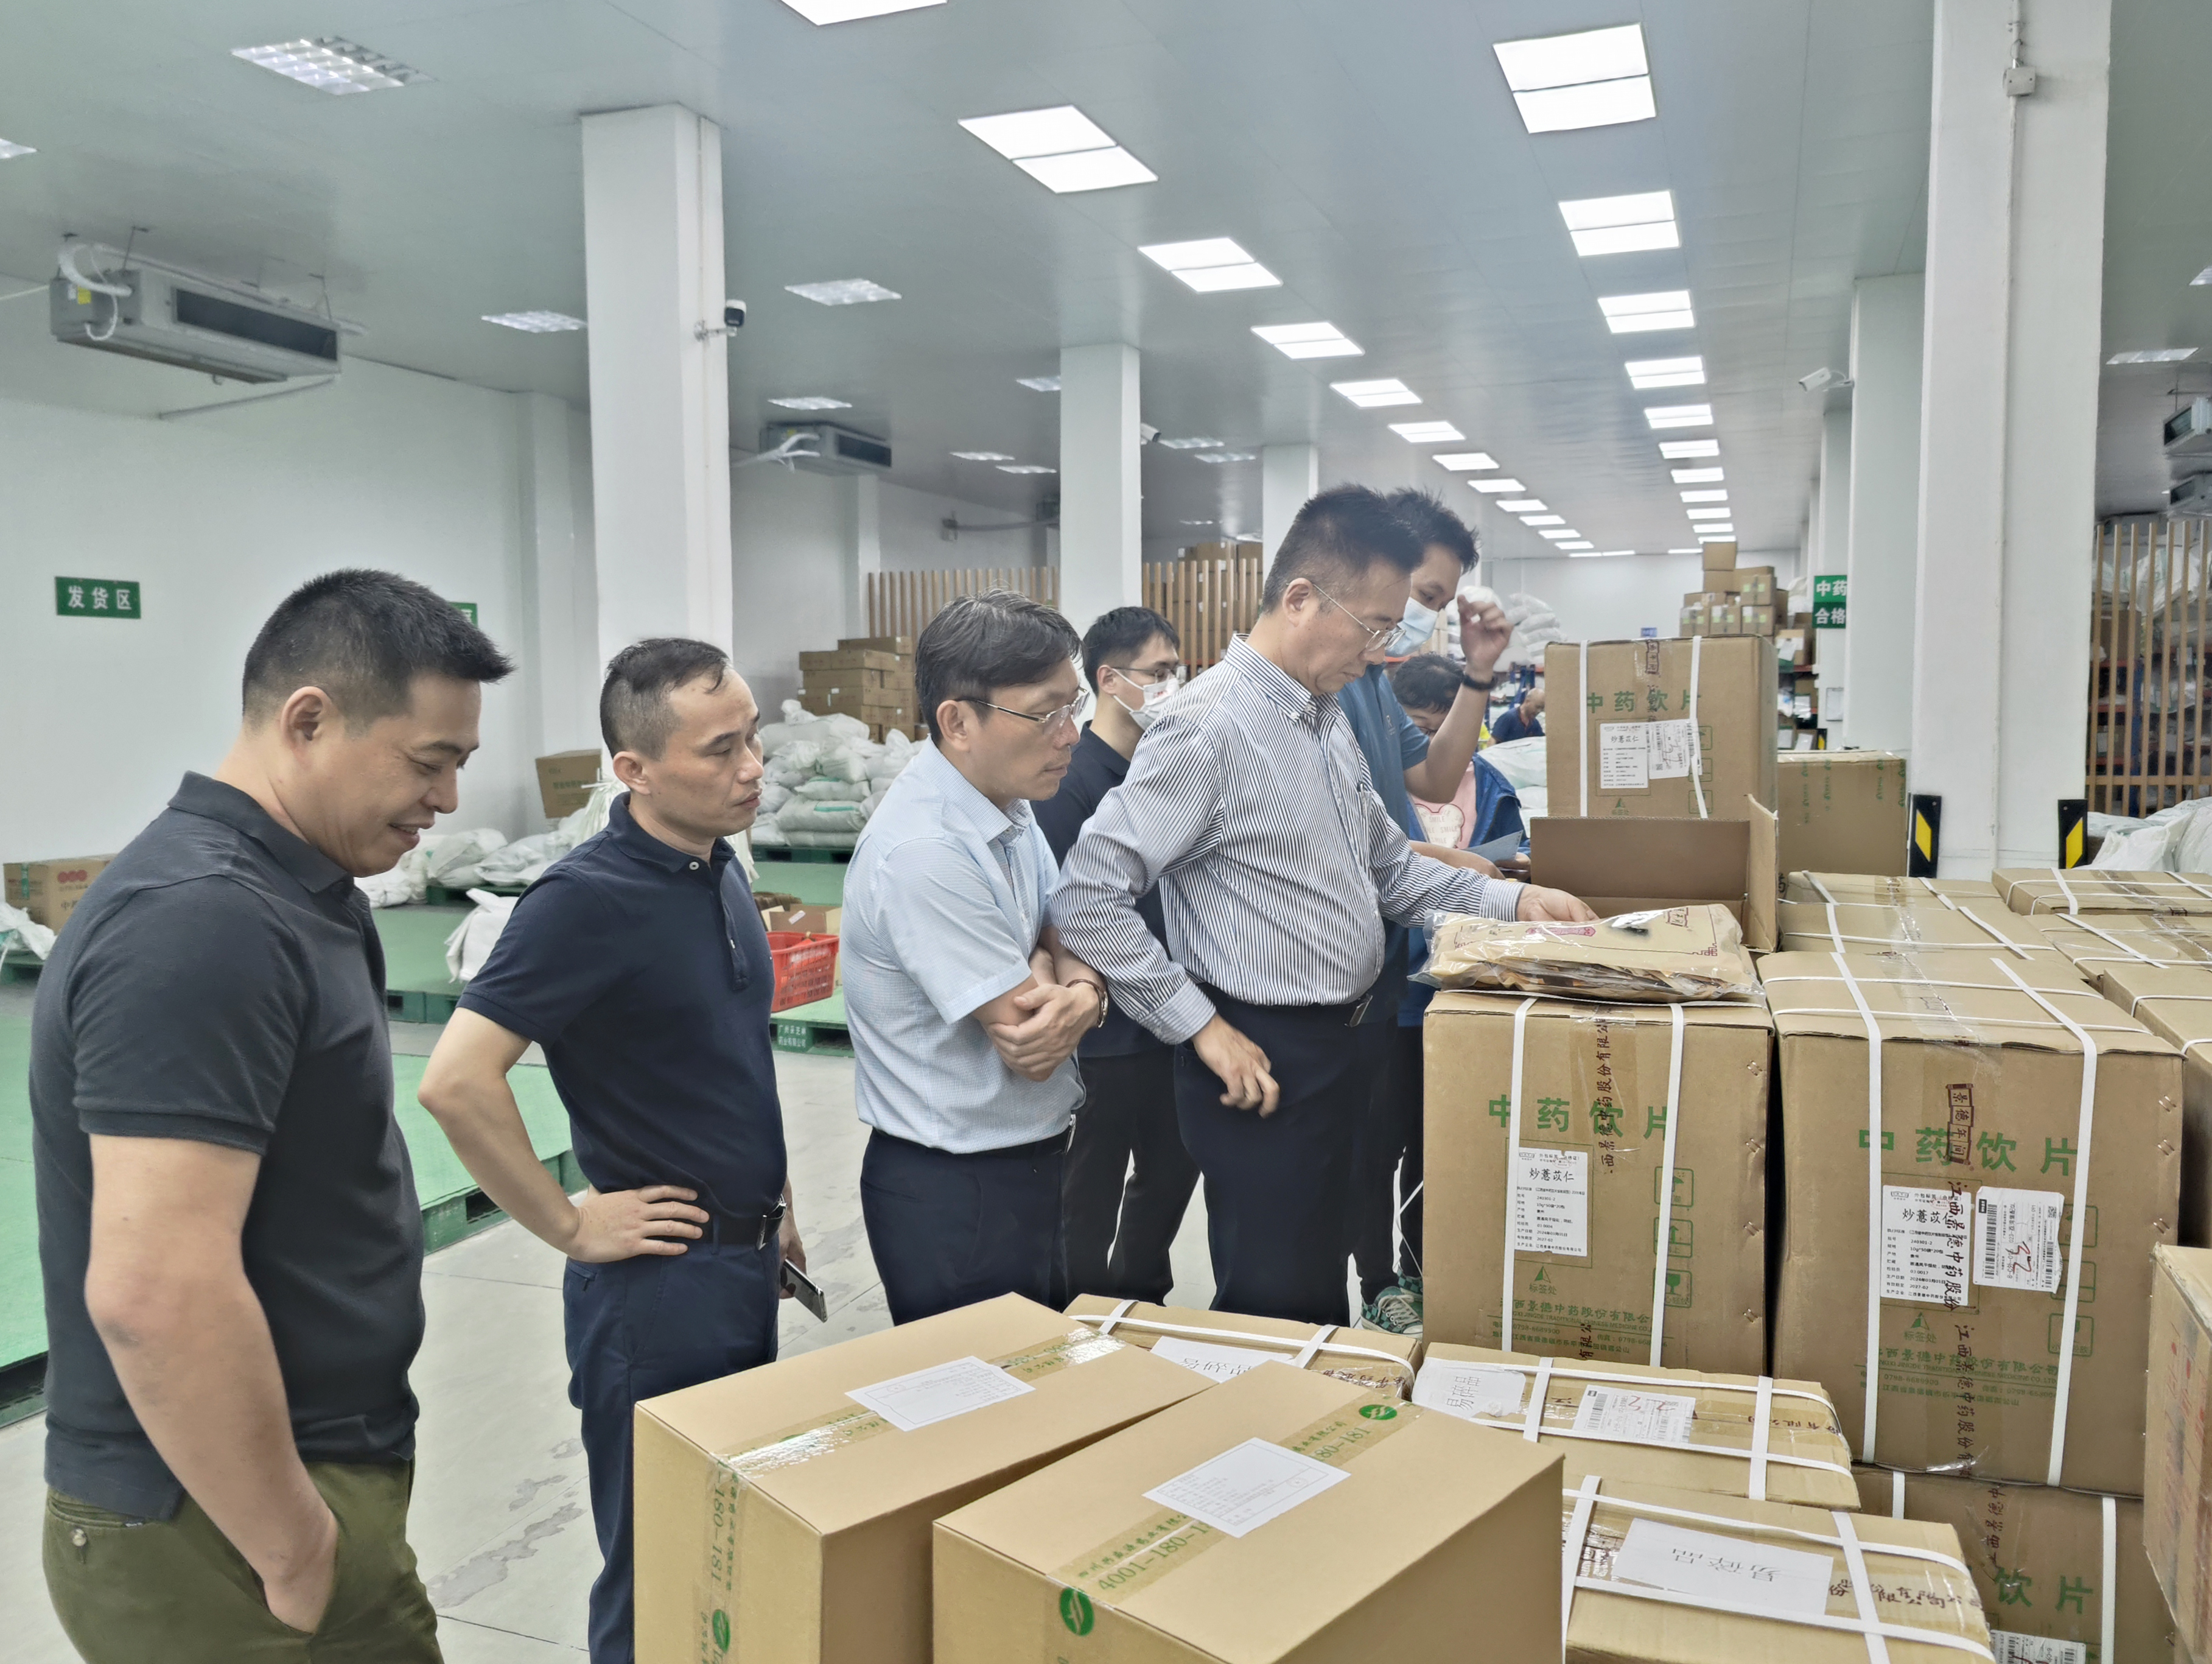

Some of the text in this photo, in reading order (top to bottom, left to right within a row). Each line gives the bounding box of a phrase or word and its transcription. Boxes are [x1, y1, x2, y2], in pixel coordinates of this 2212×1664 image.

[68, 586, 132, 609] 发货区
[1816, 580, 1847, 597] 中药
[1815, 608, 1846, 624] 合格
[1489, 1094, 1667, 1140] 中药饮片
[1952, 1092, 1970, 1156] 景德年间
[1859, 1127, 2077, 1176] 中药饮片
[1529, 1168, 1574, 1182] 炒薏苡仁
[1529, 1283, 1557, 1296] 标签处
[1904, 1331, 1936, 1344] 标签处
[1445, 1376, 1481, 1411] 易碎品
[1672, 1547, 1780, 1582] 易碎品
[1994, 1567, 2093, 1616] 饮片
